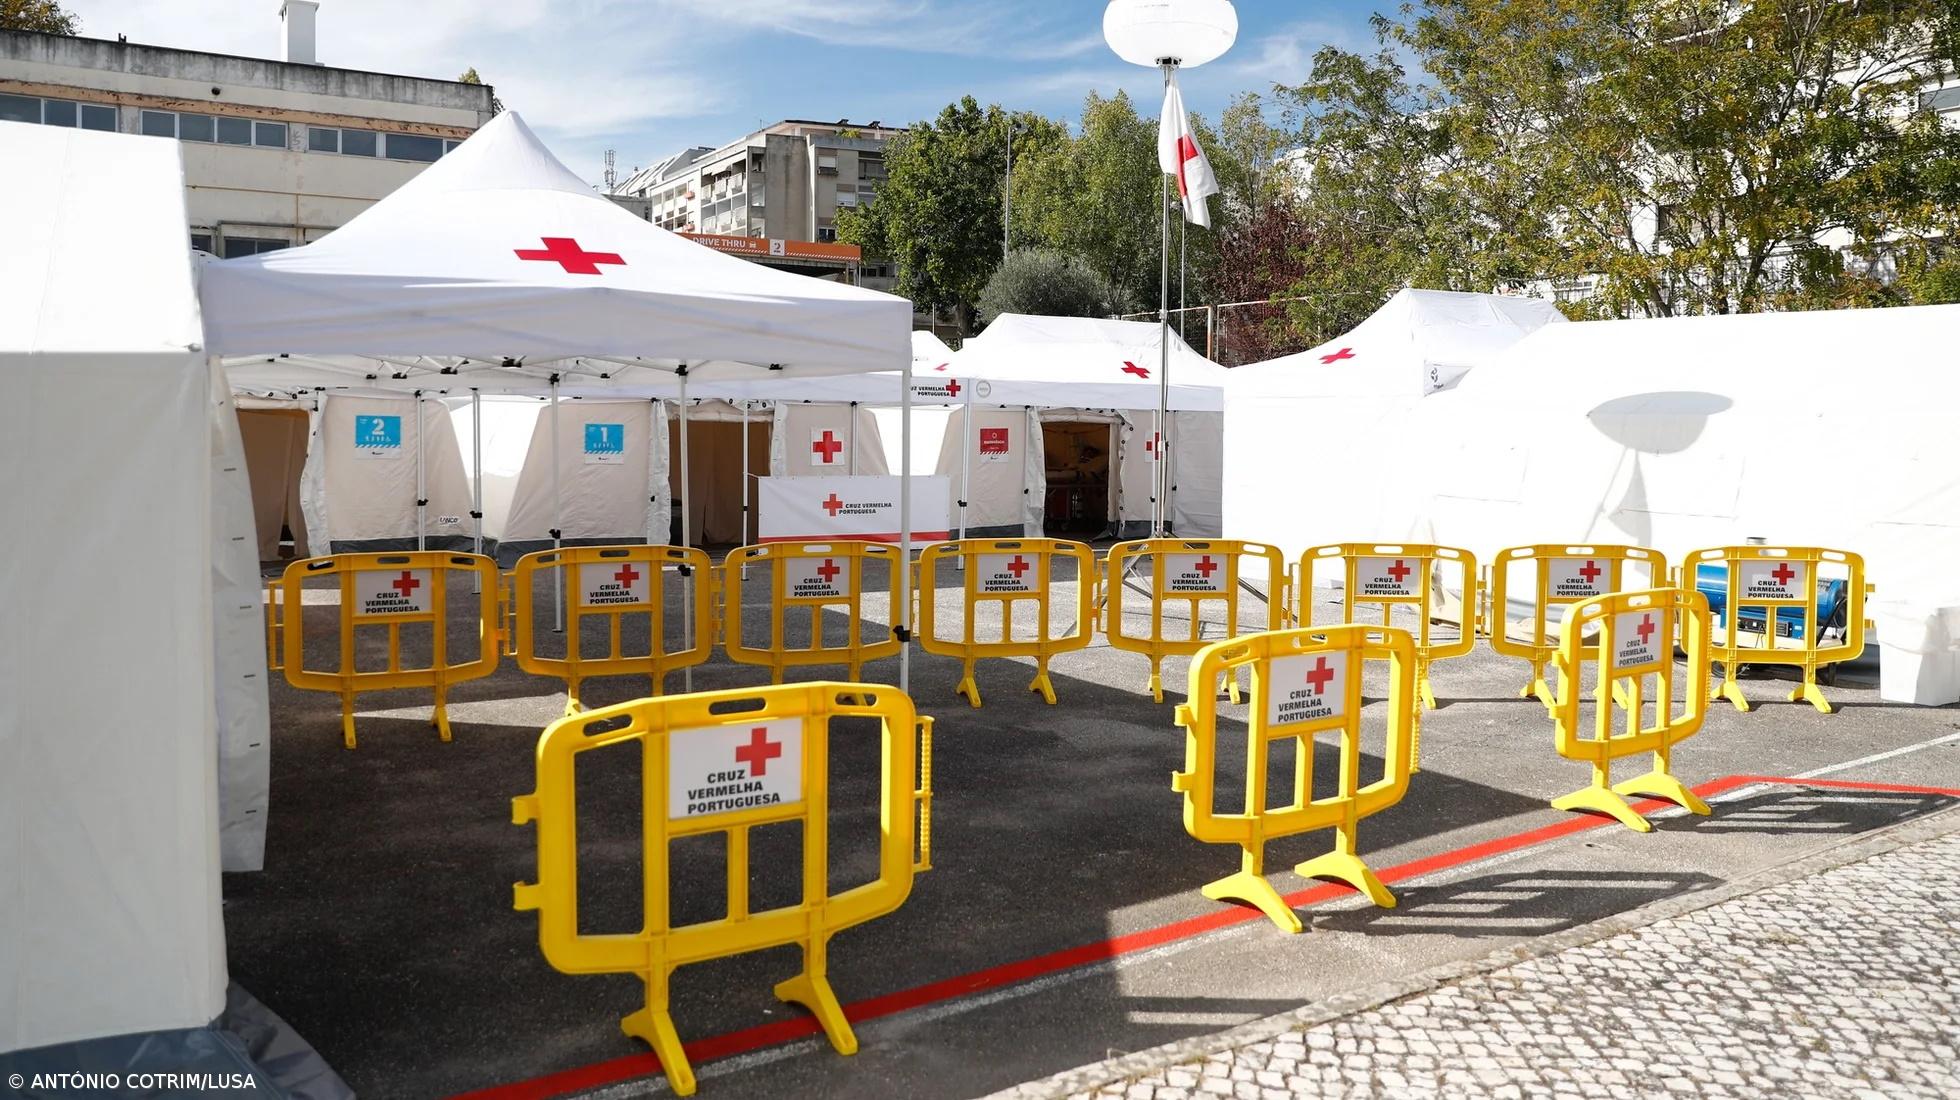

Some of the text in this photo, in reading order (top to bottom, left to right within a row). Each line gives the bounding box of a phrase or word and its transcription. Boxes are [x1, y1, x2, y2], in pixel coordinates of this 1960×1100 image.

[692, 237, 746, 248] DRIVE THRU
[372, 418, 384, 435] 2
[600, 427, 608, 442] 1
[590, 590, 630, 598] VERMELHA
[590, 596, 639, 604] PORTUGUESA
[366, 606, 420, 614] PORTUGUESA
[1626, 639, 1640, 648] CRUZ
[1619, 647, 1647, 657] VERMELHA
[1618, 654, 1654, 666] PORTUGUESA
[1290, 689, 1312, 700] CRUZ
[1278, 698, 1322, 712] VERMELHA
[1278, 707, 1332, 722] PORTUGUESA
[707, 769, 745, 784] CRUZ
[688, 781, 763, 800] VERMELHA
[688, 792, 781, 814] PORTUGUESA
